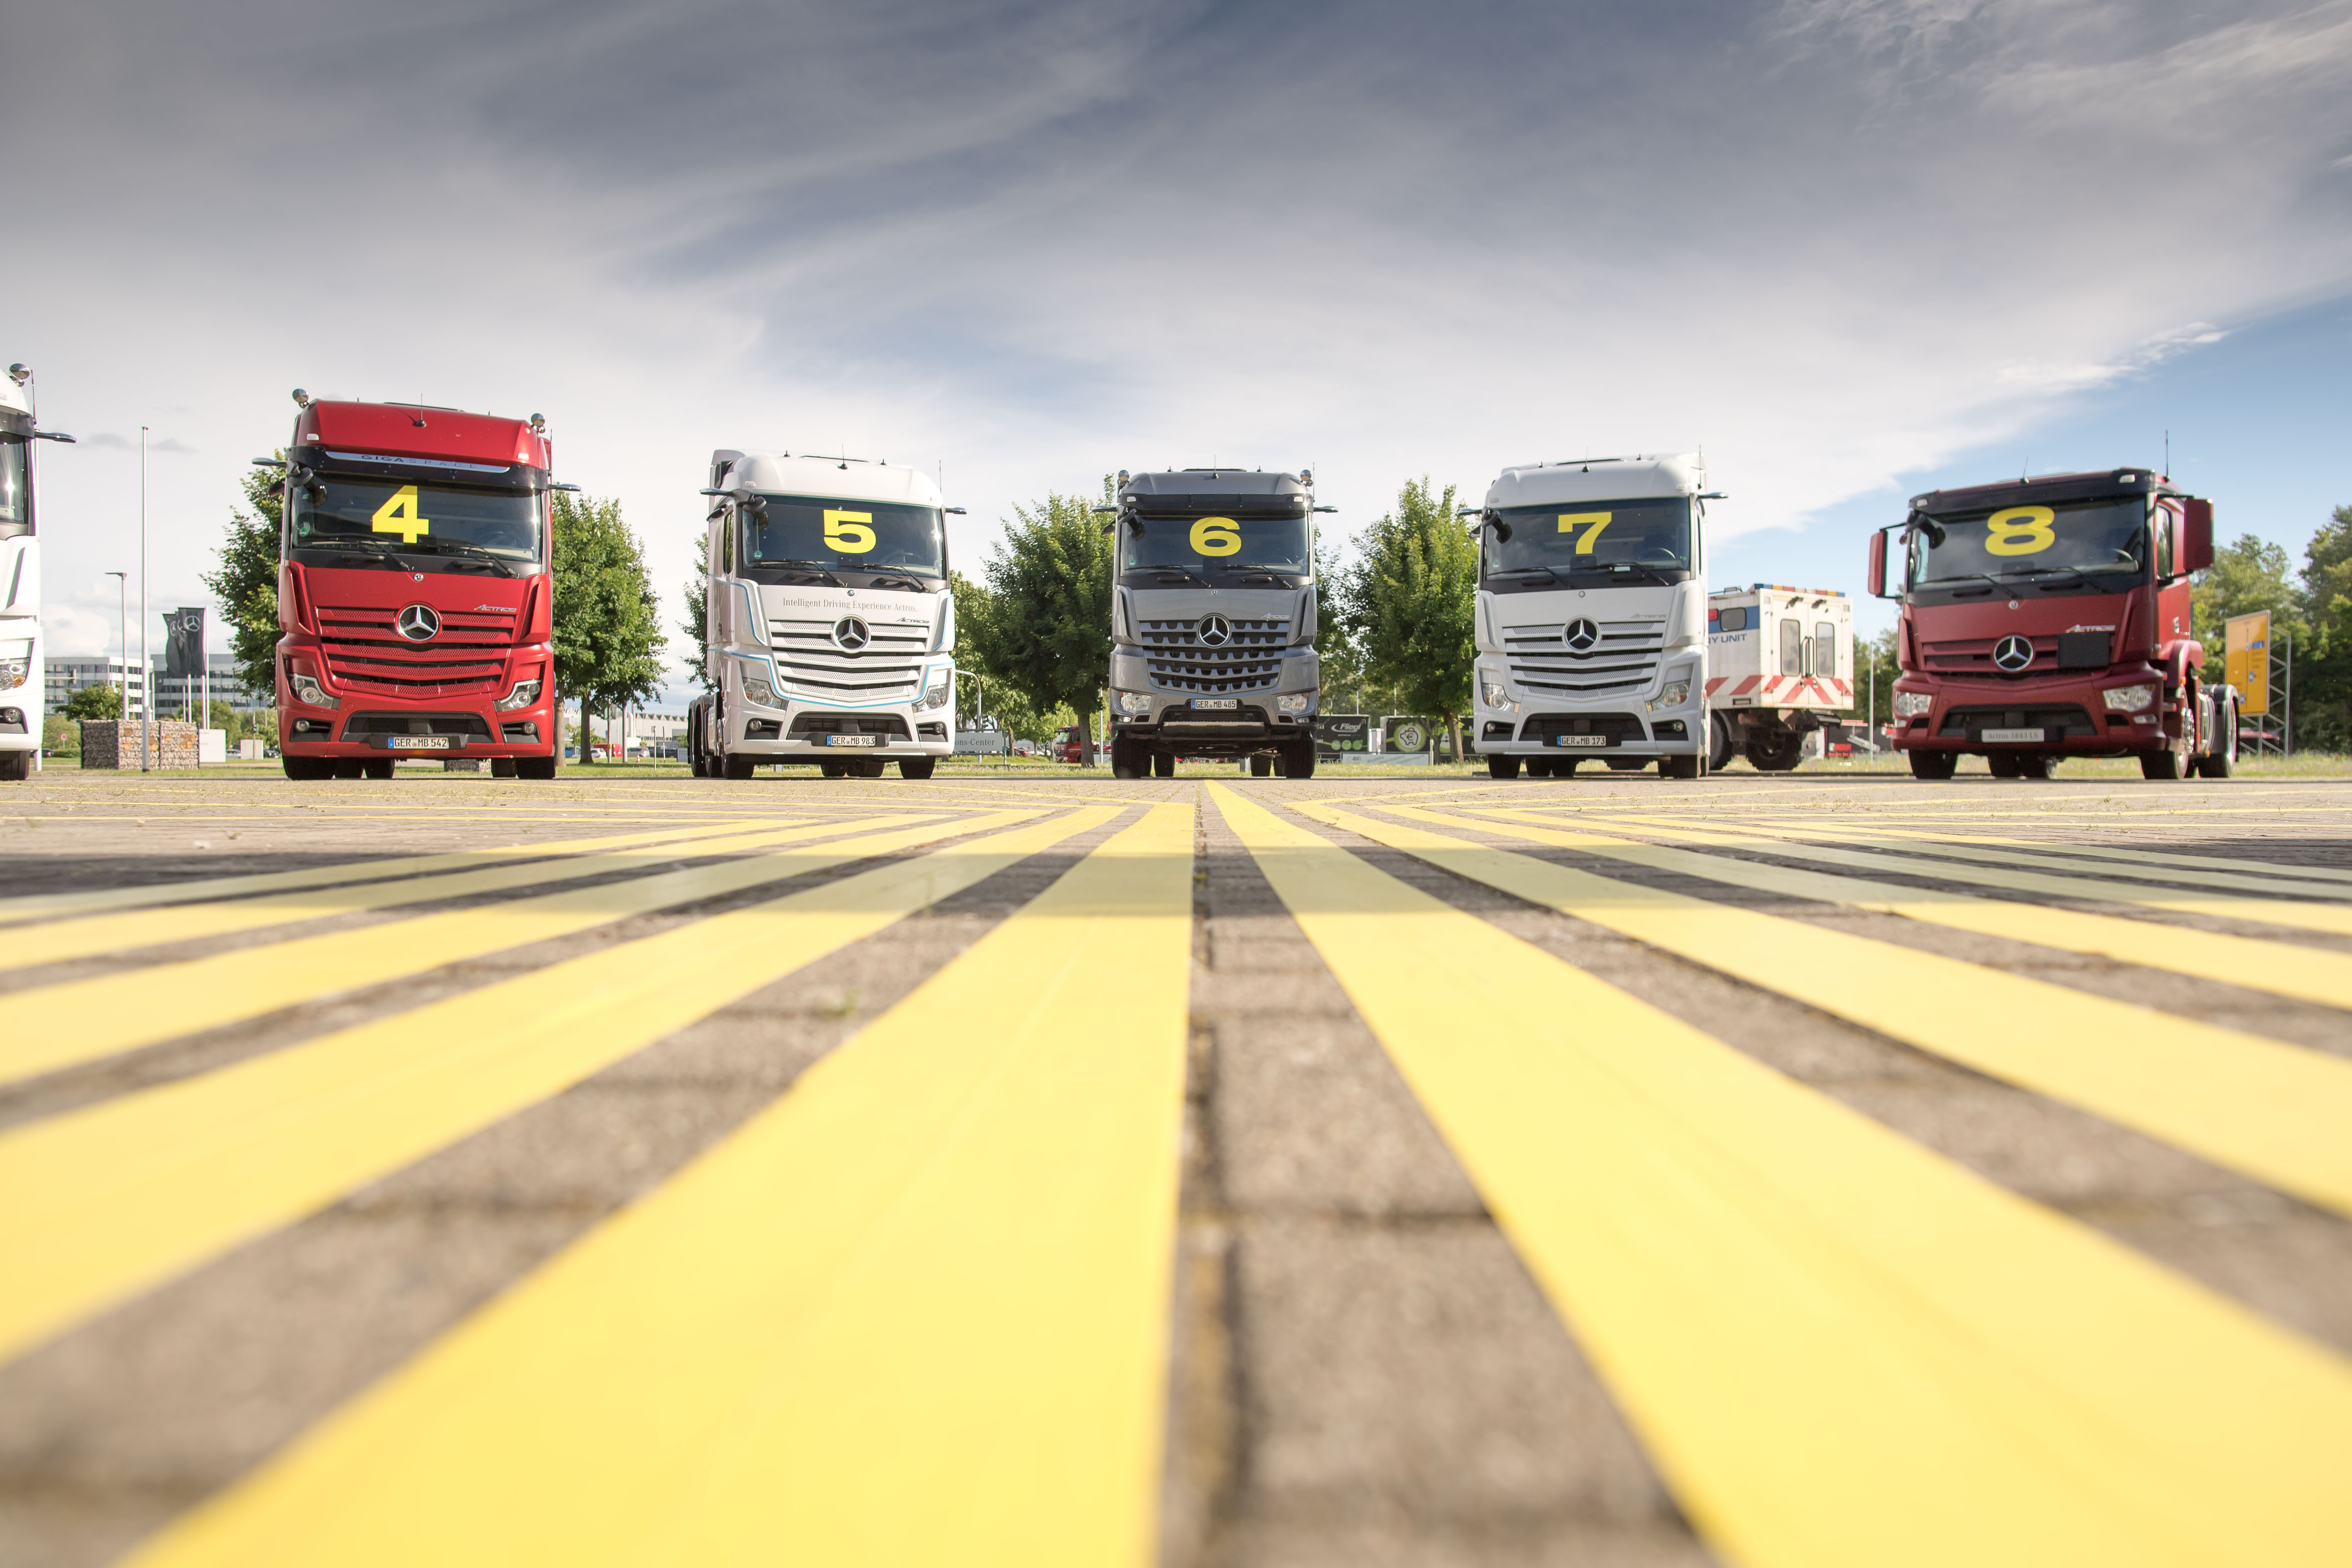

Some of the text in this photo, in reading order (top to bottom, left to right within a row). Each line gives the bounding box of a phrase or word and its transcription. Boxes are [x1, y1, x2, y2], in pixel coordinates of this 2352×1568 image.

[372, 485, 429, 544] 4
[823, 509, 877, 554] 5
[1189, 517, 1242, 556] 6
[1557, 511, 1612, 555] 7
[1985, 506, 2055, 555] 8
[783, 598, 917, 612] Intelligent Driving Experience Actros.
[1721, 633, 1747, 643] UNIT
[395, 738, 447, 747] GER MB 542
[832, 737, 845, 745] GER
[862, 737, 874, 745] 983
[1562, 737, 1605, 745] GER MB 173
